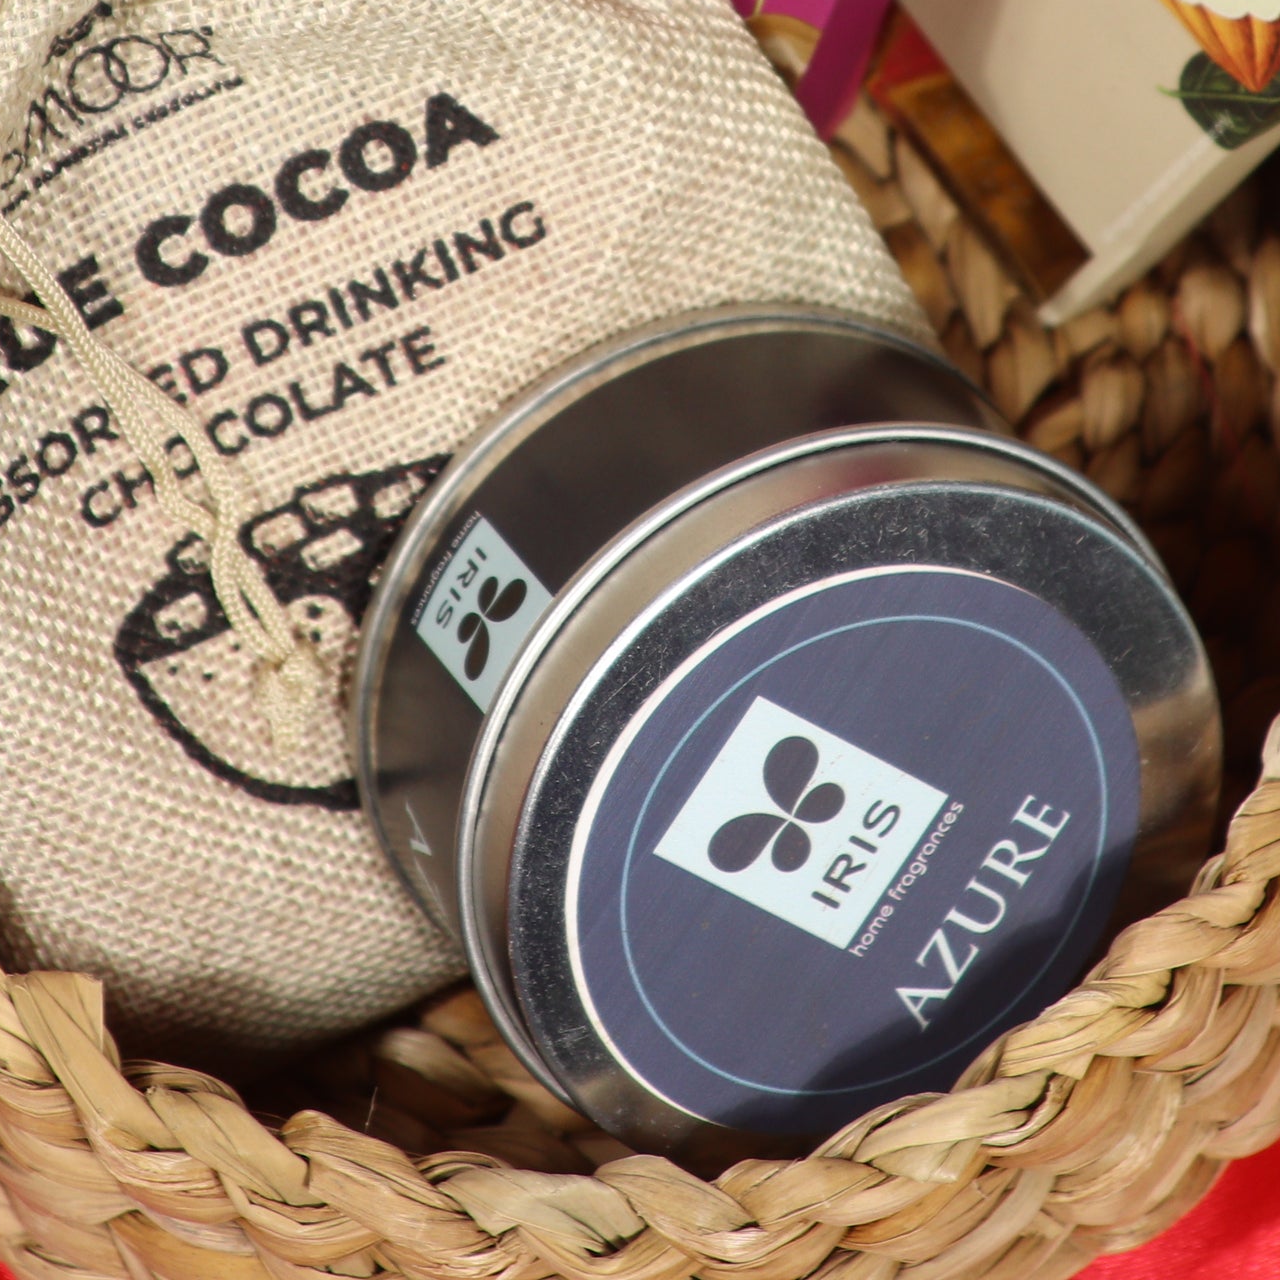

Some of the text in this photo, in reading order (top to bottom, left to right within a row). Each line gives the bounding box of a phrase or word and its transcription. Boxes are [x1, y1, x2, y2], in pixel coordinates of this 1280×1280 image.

[134, 91, 501, 288] COCOA
[241, 200, 548, 367] DRINKING
[435, 546, 488, 630] IRIS
[810, 799, 902, 910] IRIS
[848, 800, 965, 958] home fragrances
[894, 793, 1072, 1032] AZURE
